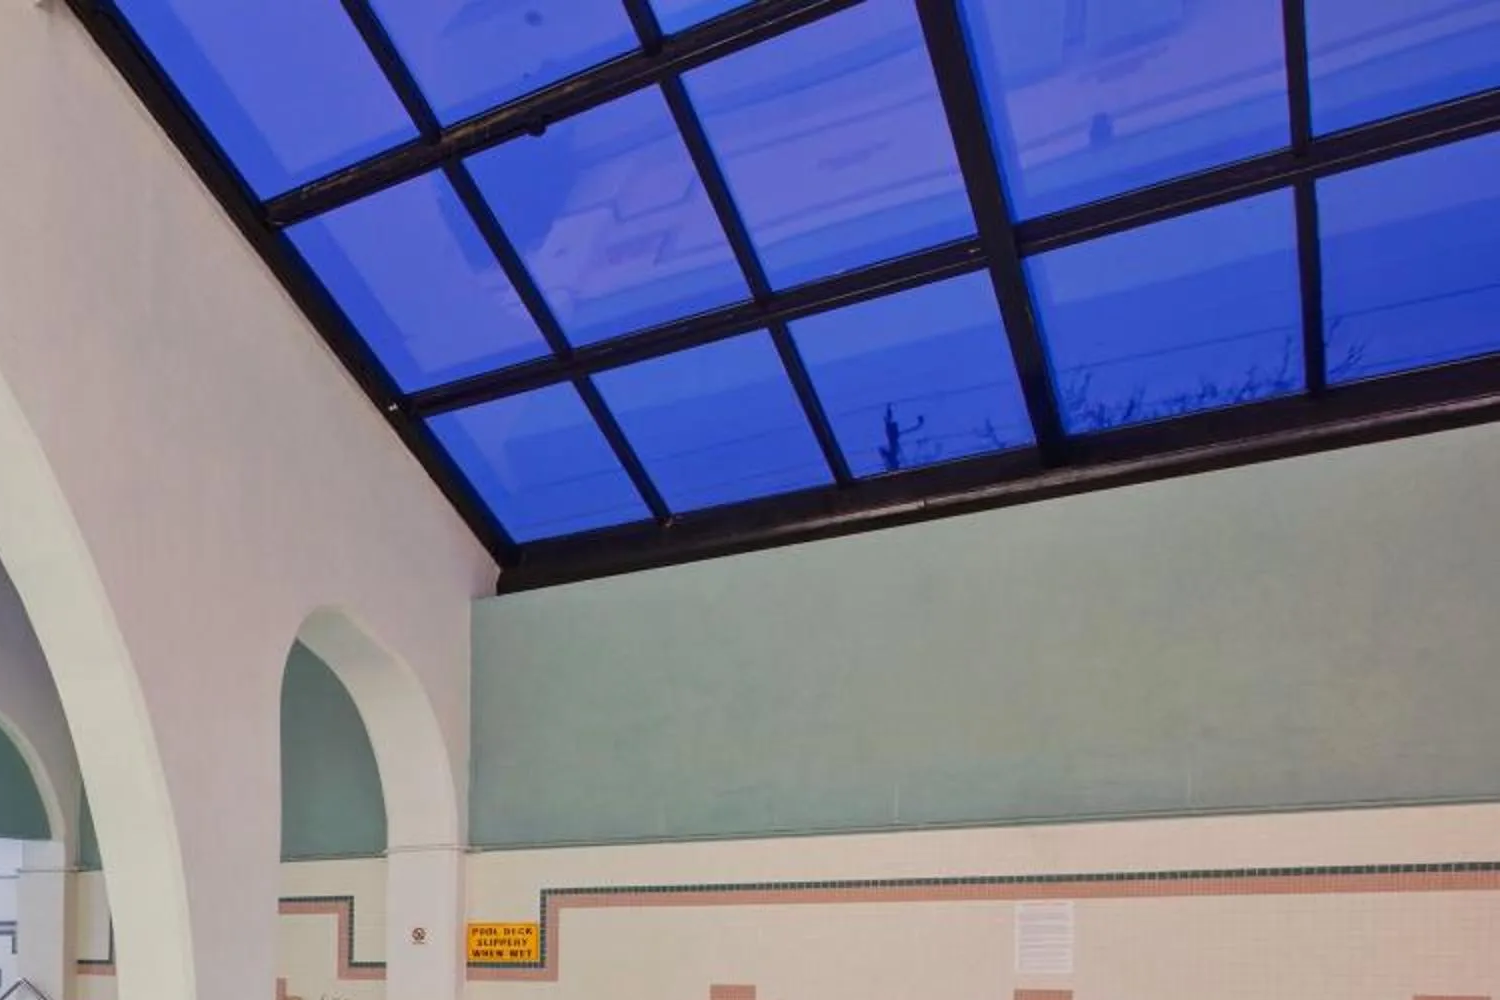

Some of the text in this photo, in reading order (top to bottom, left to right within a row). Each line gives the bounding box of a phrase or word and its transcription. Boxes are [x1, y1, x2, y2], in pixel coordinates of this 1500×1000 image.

[471, 927, 533, 935] POOL DECK
[476, 938, 528, 946] SLIPPERY
[471, 949, 532, 957] WHEN WET
